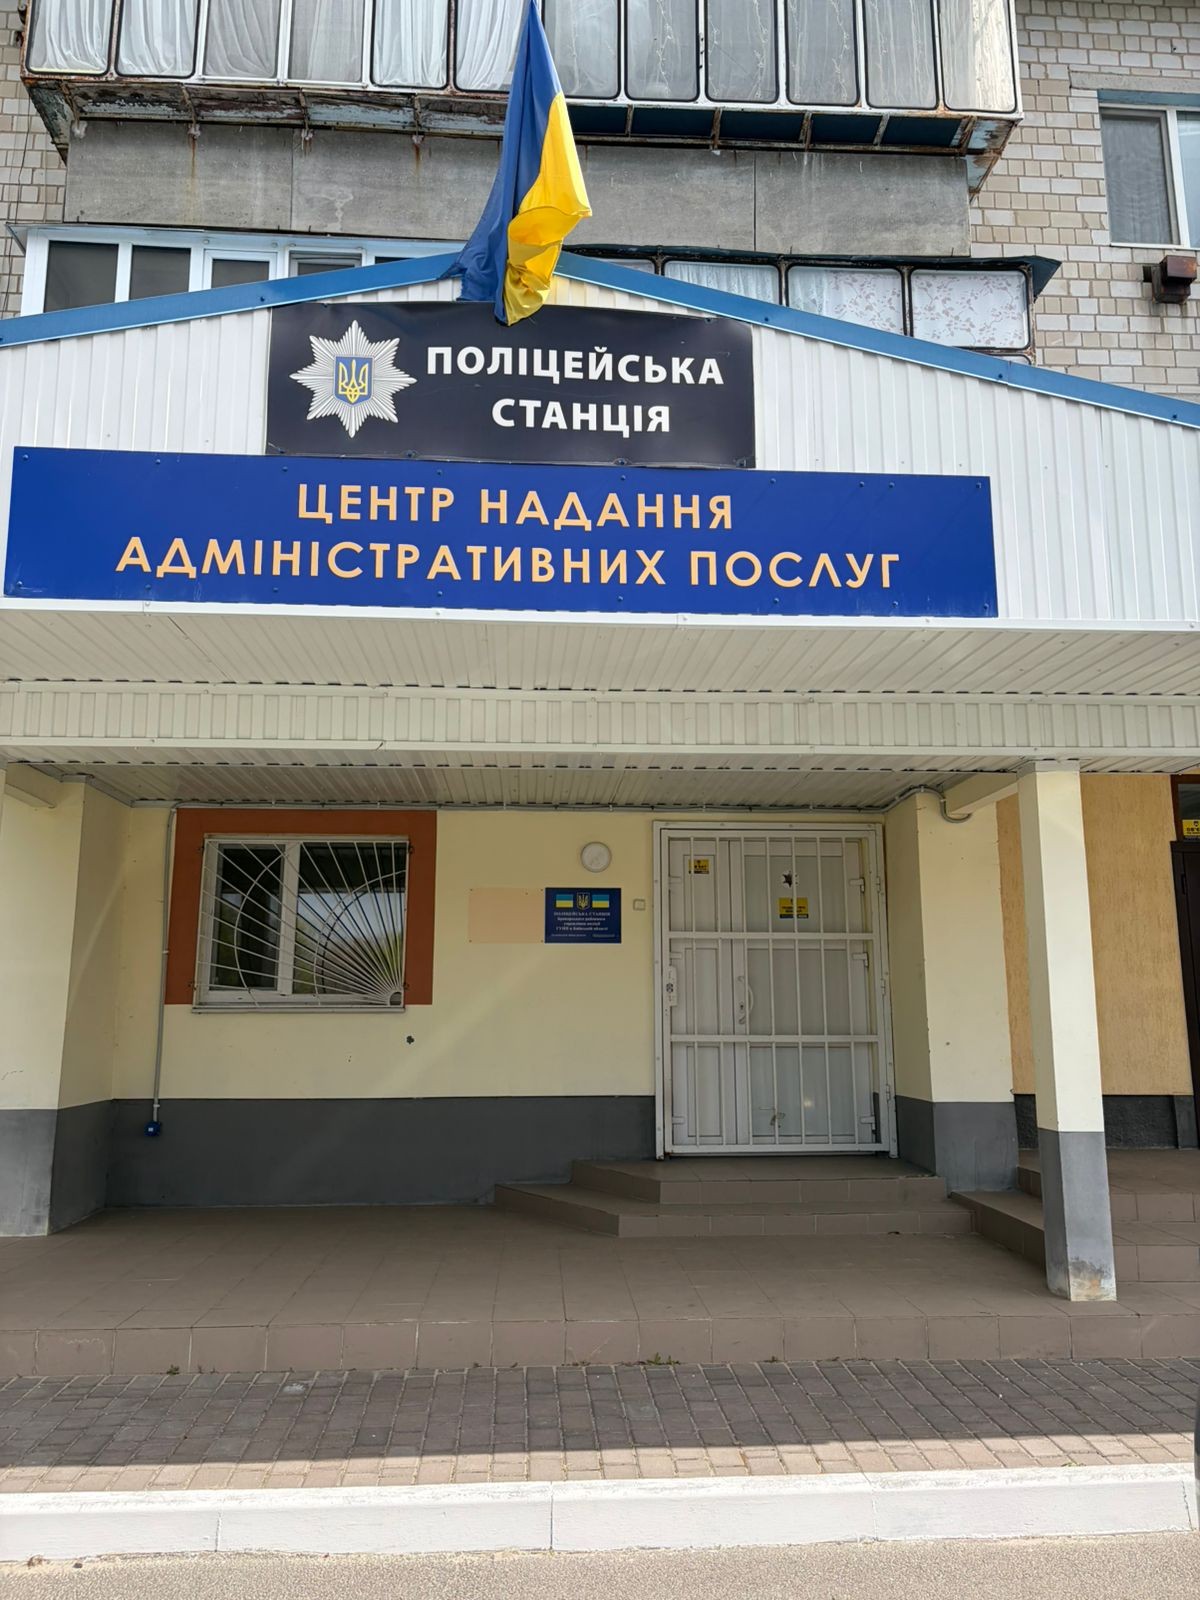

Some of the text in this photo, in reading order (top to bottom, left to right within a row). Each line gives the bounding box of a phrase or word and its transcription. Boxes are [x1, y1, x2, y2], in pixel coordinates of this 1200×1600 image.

[427, 346, 724, 385] ПОЛІЦЕЙСЬКА
[491, 398, 670, 439] СТАНЦІЯ
[298, 483, 732, 533] ЦЕНТР НАДАННЯ
[115, 536, 900, 589] АДМІНІСТРАТИВНИХ ПОСЛУГ
